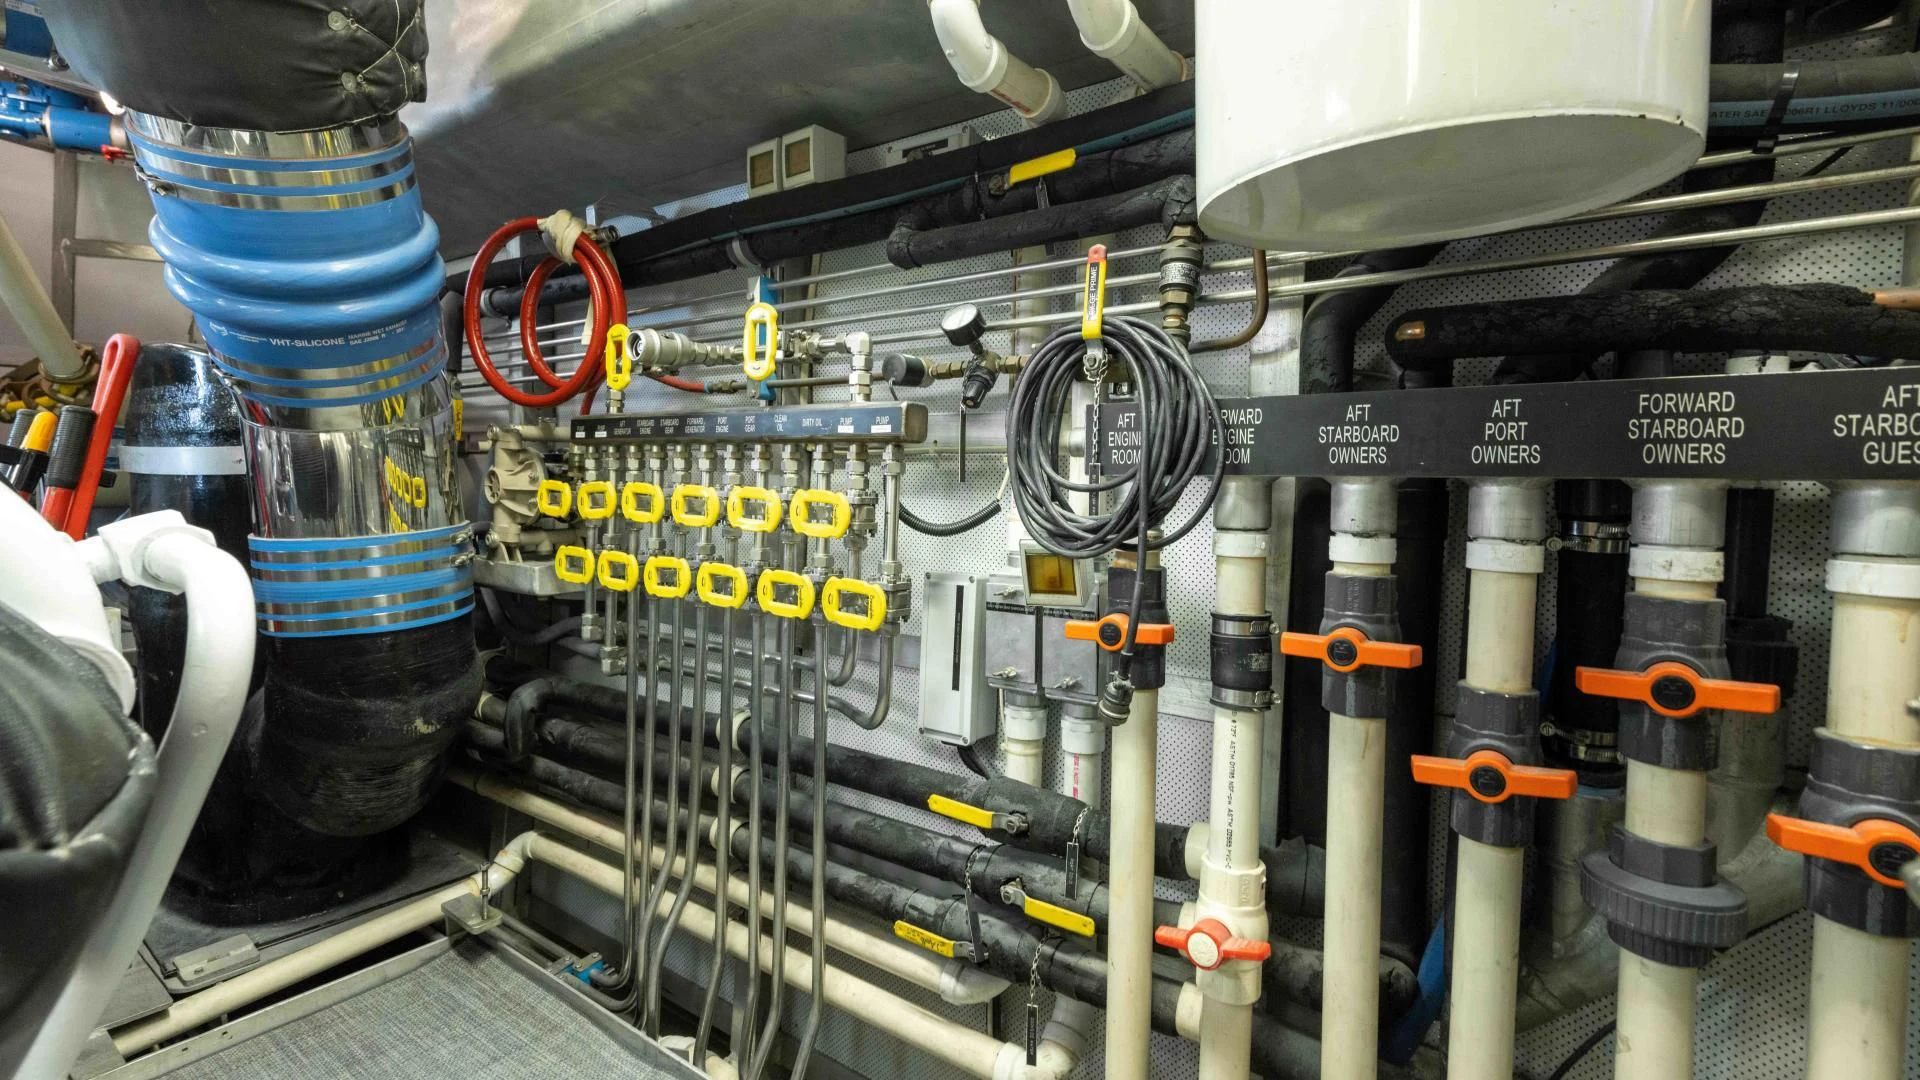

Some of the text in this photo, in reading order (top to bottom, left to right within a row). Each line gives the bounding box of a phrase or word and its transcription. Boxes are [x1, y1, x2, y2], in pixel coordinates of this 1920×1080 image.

[1709, 111, 1740, 119] ATER
[1090, 265, 1098, 291] PRIME
[269, 336, 346, 348] VHT-SILICONE
[1639, 391, 1736, 414] FORWARD
[1882, 385, 1920, 408] AFT
[1208, 407, 1263, 425] RWARD
[1345, 404, 1371, 422] AFT
[1491, 398, 1522, 418] AFT
[660, 418, 679, 427] STARBOARD
[686, 417, 705, 425] FORWARD
[717, 416, 728, 424] PORT
[745, 415, 756, 424] PORT
[773, 414, 788, 423] CLEAN
[802, 418, 823, 427] DIRTY OIL
[839, 417, 853, 426] PUMP
[875, 415, 890, 425] PUMP
[1117, 412, 1136, 429] AFT
[1833, 413, 1920, 437] STARBO
[639, 427, 651, 435] ENGINE
[664, 426, 674, 434] GEAR
[684, 426, 706, 434] GENERATOR
[715, 425, 729, 433] ENGINE
[744, 424, 756, 432] GEAR
[776, 423, 784, 432] OIL
[1318, 425, 1400, 444] STARBOARD
[1484, 421, 1529, 441] PORT
[1627, 417, 1745, 439] STARBOARD
[1108, 431, 1142, 447] ENGIN
[1212, 428, 1255, 445] EGINE
[1111, 449, 1141, 465] ROOM
[1216, 447, 1250, 464] OOM
[1328, 446, 1387, 465] OWNERS
[1471, 444, 1541, 464] OWNERS
[1642, 443, 1726, 465] OWNERS
[1863, 441, 1920, 465] GUES
